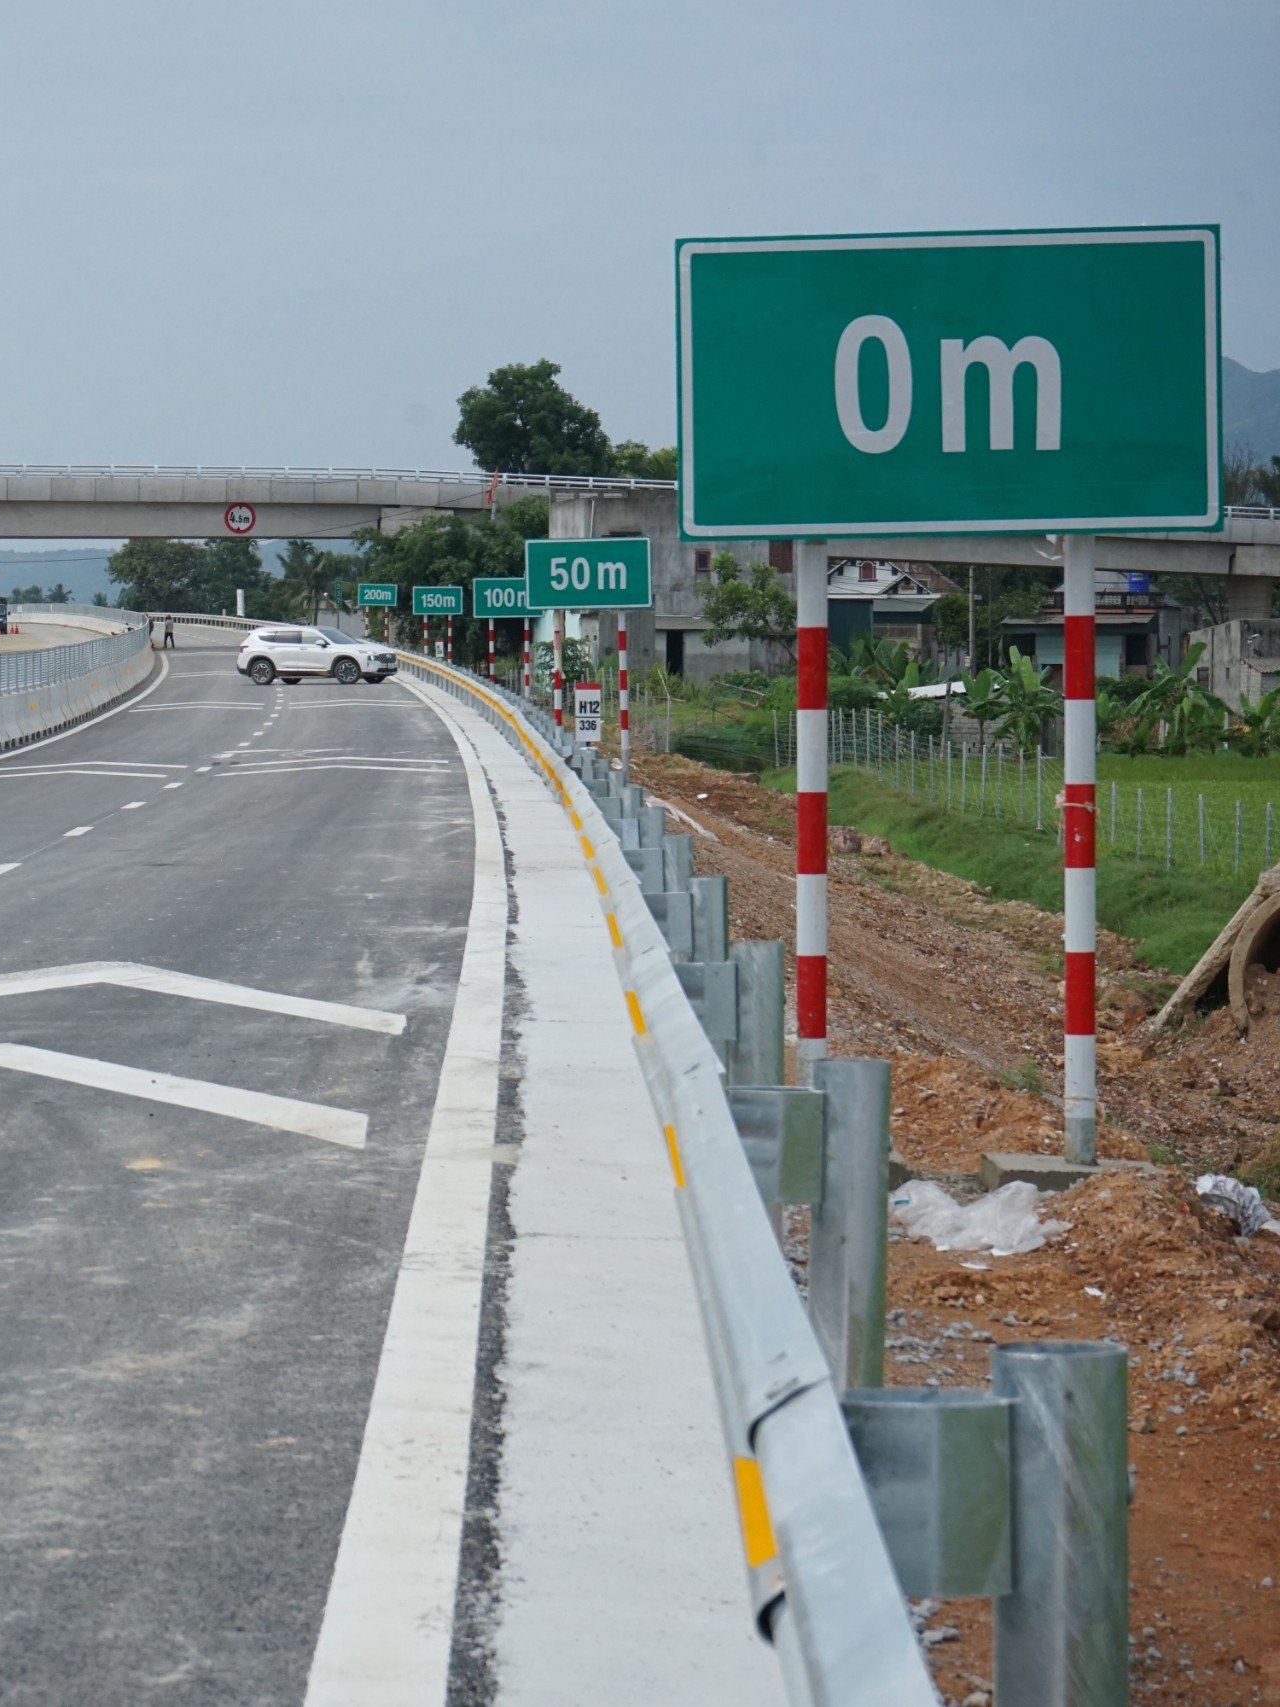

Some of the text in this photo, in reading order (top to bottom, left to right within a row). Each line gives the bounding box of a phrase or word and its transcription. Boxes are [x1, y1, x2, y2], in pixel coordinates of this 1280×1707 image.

[363, 589, 392, 600] 200m
[420, 593, 455, 608] 150m
[579, 700, 600, 714] H12
[579, 720, 597, 731] 336
